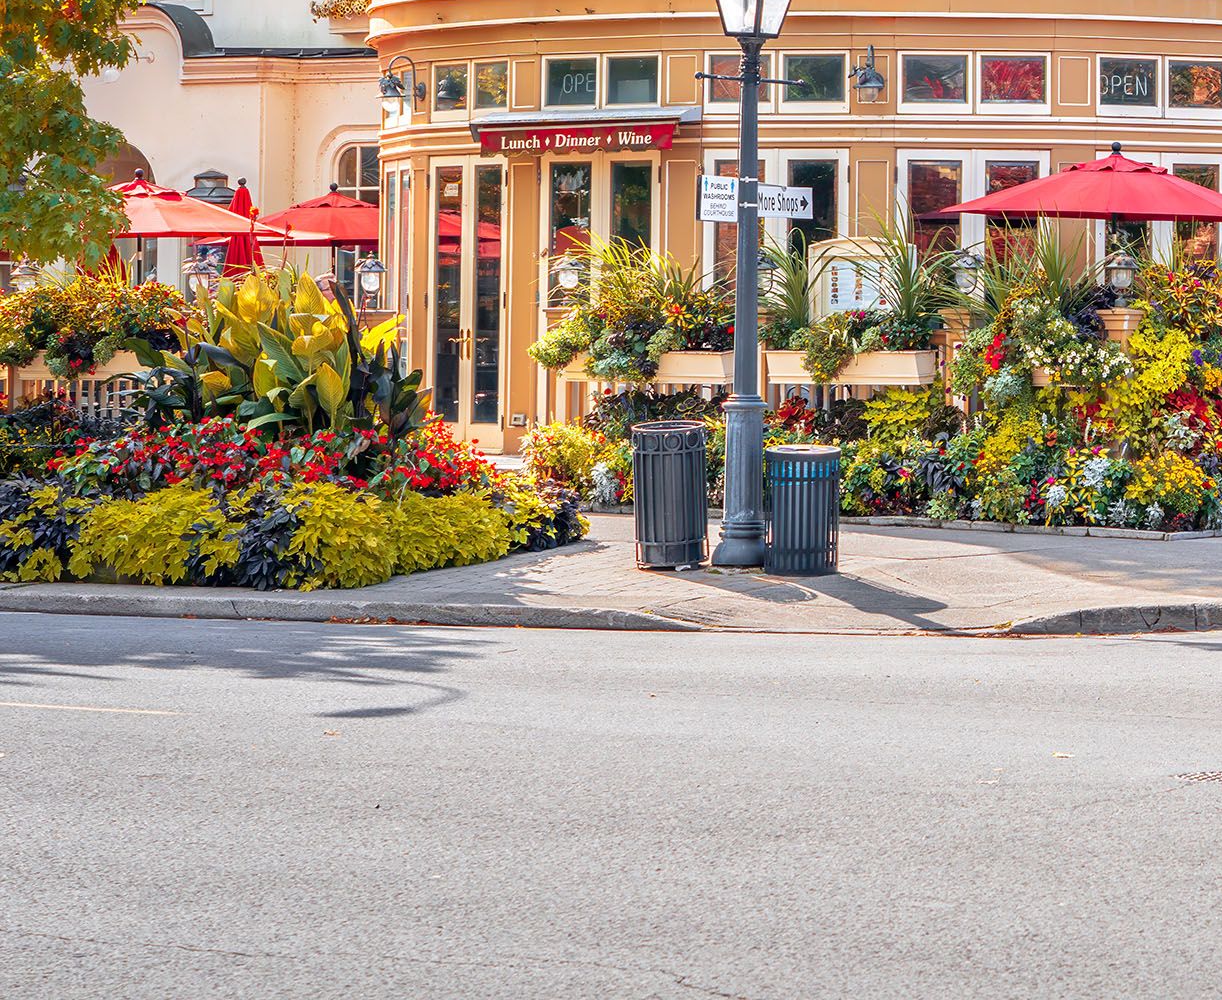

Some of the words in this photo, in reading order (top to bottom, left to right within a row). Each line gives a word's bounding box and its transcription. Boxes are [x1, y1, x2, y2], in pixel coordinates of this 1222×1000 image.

[563, 73, 595, 94] OPE
[1100, 74, 1147, 96] OPEN
[501, 136, 541, 150] Lunch
[555, 133, 601, 148] Dinner
[618, 131, 652, 145] Wine
[710, 182, 728, 190] PUBLIC
[703, 193, 735, 201] WASHROOMS
[710, 202, 727, 210] BEHIND
[758, 192, 775, 211] More
[777, 193, 799, 216] Shops
[703, 209, 735, 217] COURTHOUSE
